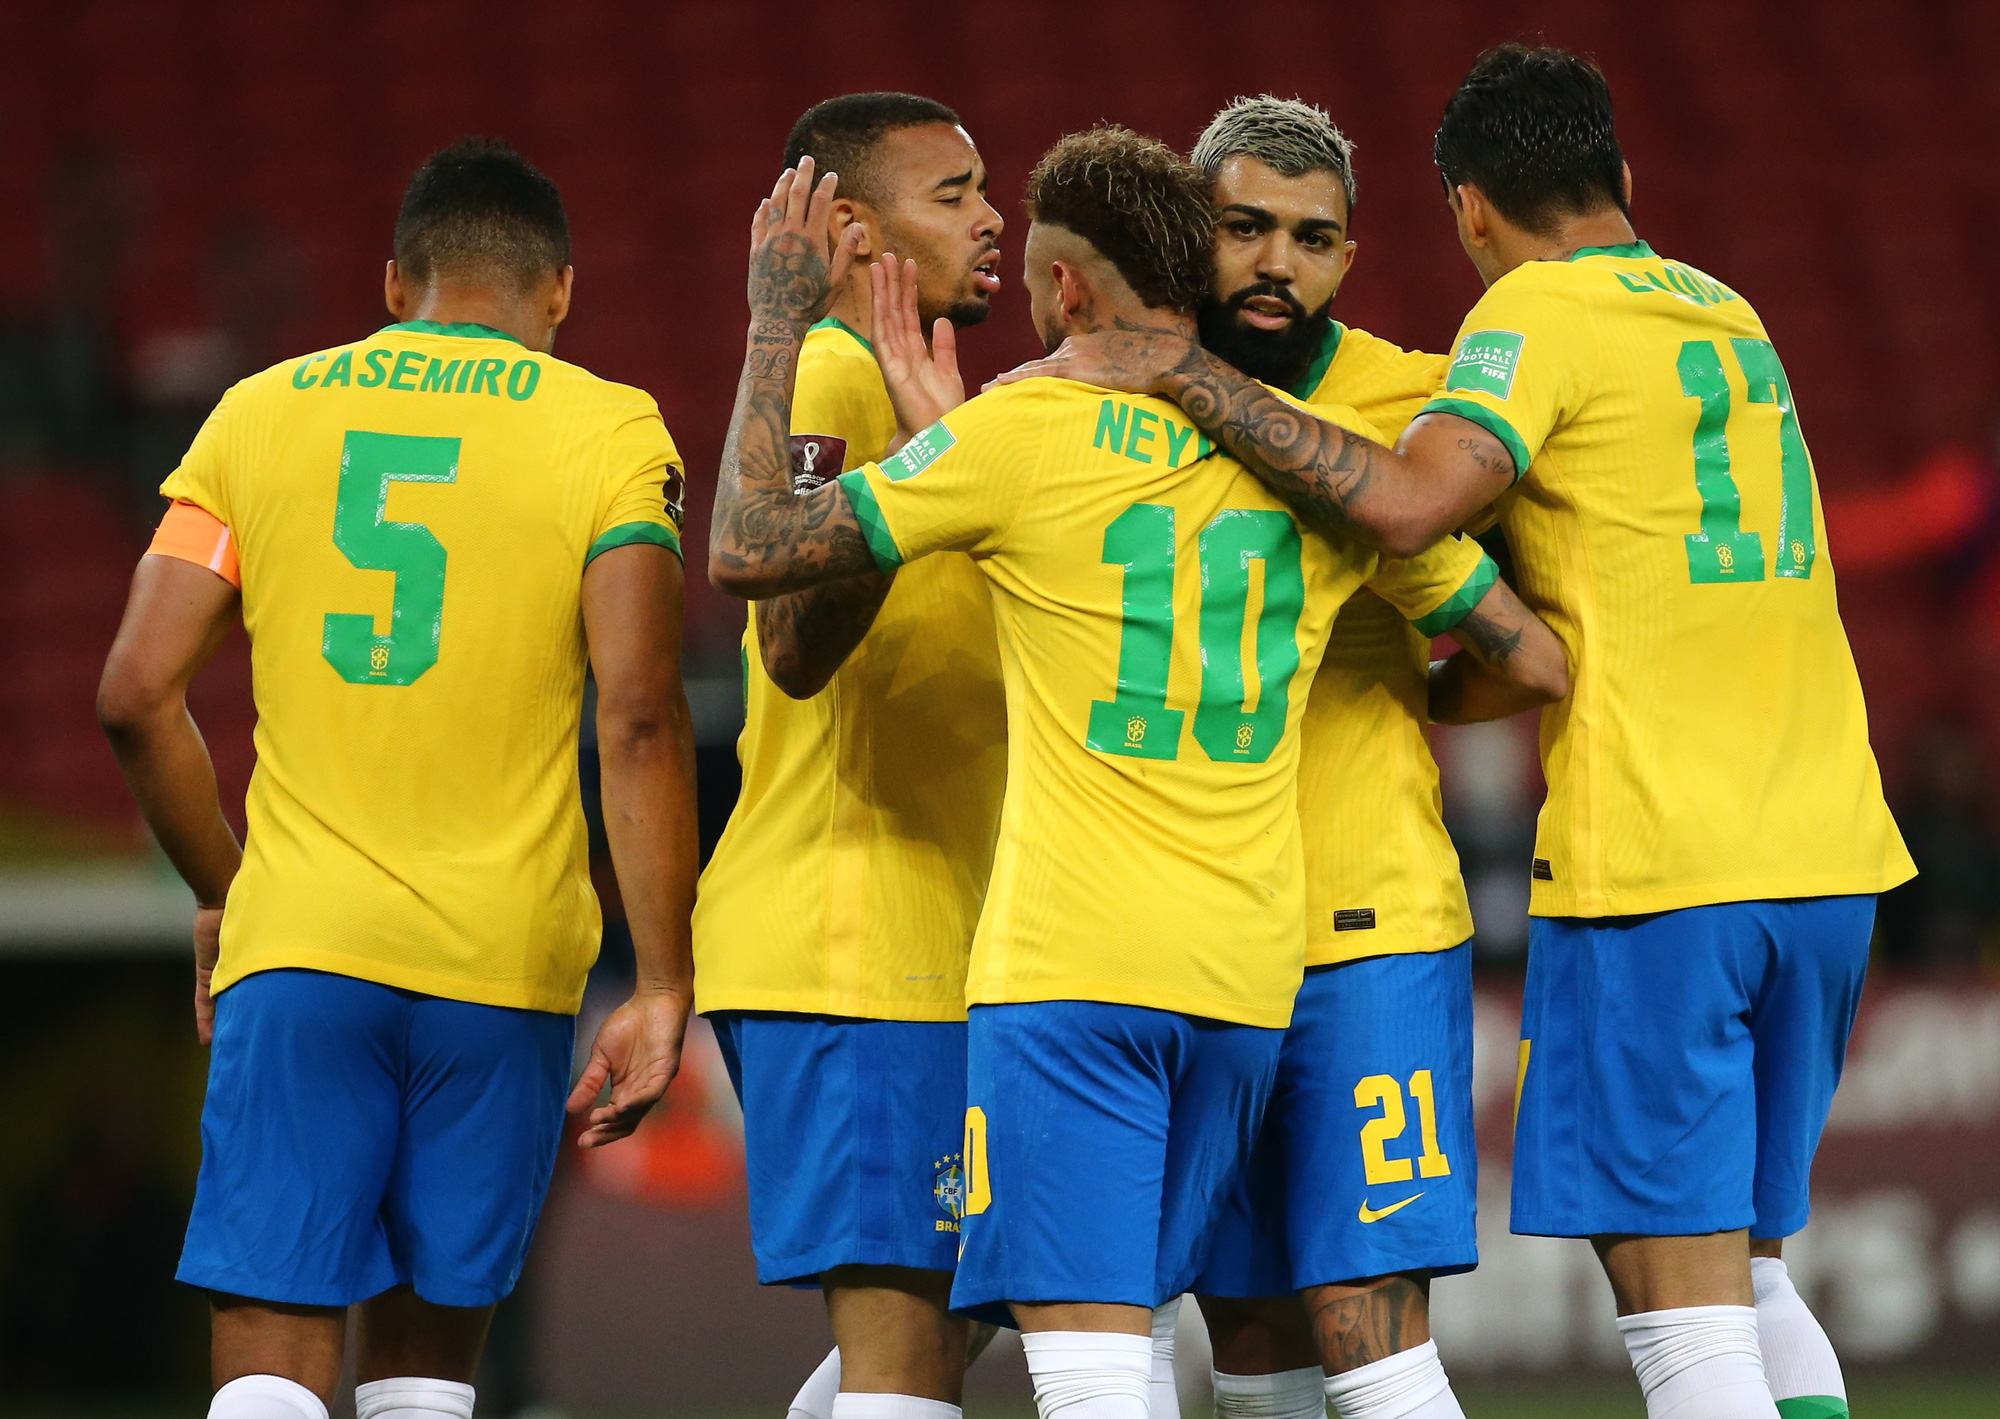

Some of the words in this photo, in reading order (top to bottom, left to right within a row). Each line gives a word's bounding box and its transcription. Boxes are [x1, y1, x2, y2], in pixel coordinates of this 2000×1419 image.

[292, 349, 541, 402] CASEMIRO
[1481, 366, 1507, 380] FIFA
[897, 450, 918, 473] FIFA
[1676, 337, 1815, 584] 17
[321, 430, 463, 687] 5
[1085, 502, 1305, 764] 10
[1353, 1069, 1452, 1185] 21
[943, 1187, 958, 1196] CBF
[935, 1219, 961, 1233] BRA
